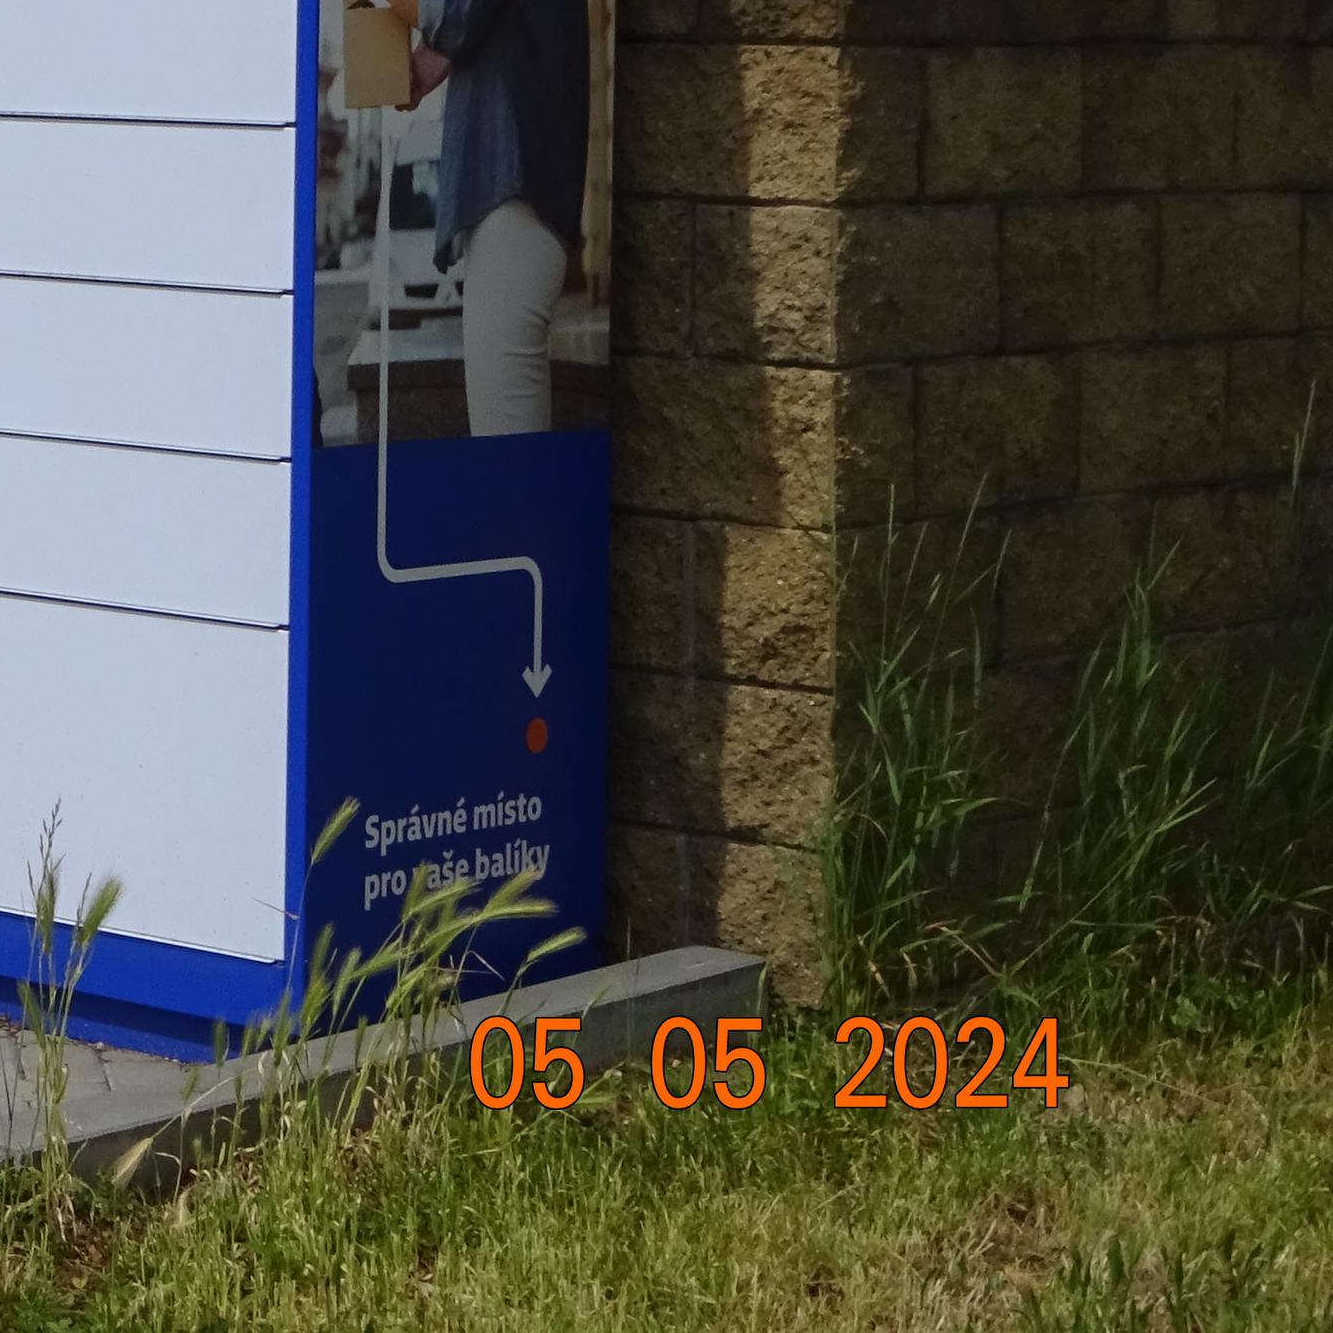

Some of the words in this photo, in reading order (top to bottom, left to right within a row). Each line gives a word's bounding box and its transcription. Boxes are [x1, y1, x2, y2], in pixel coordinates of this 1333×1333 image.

[364, 796, 467, 856] Správné
[473, 790, 542, 830] místo
[364, 867, 407, 911] pro
[475, 837, 550, 881] balíky
